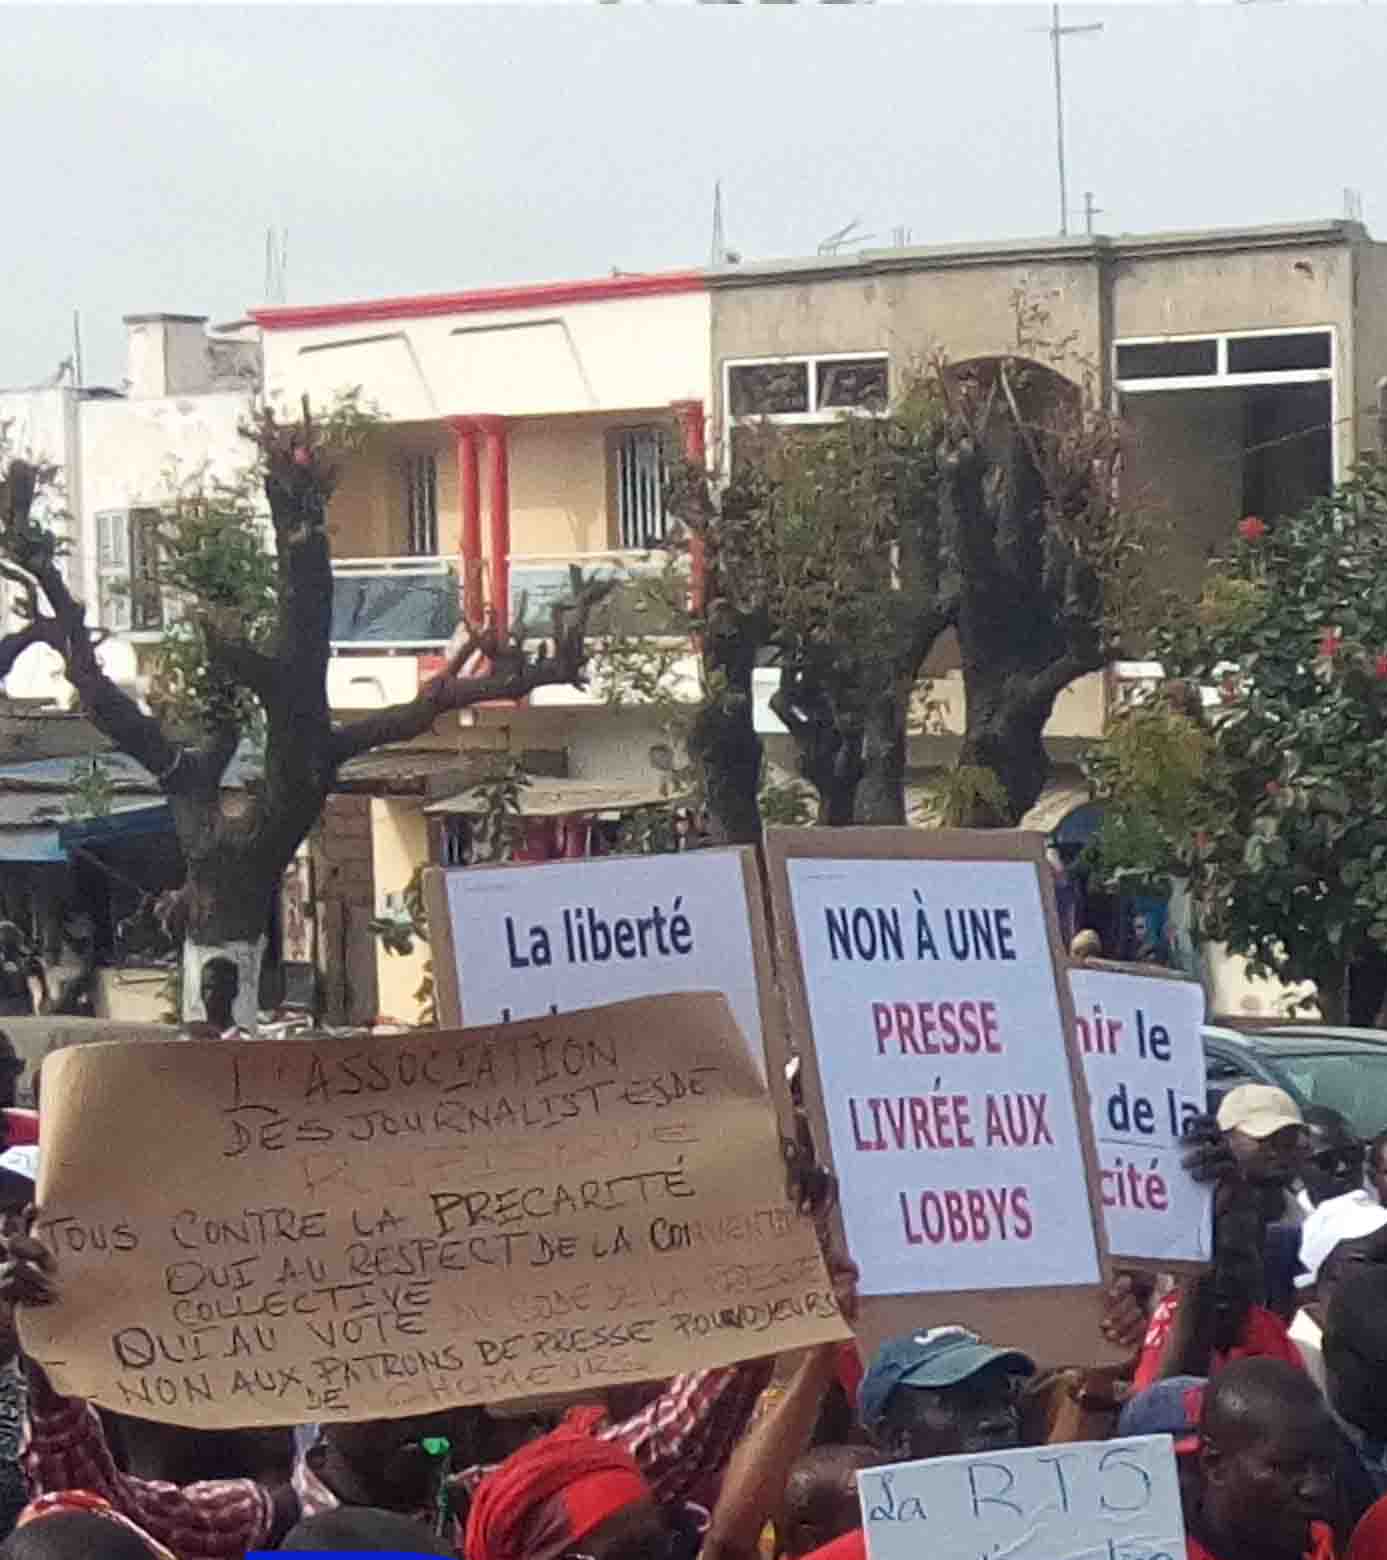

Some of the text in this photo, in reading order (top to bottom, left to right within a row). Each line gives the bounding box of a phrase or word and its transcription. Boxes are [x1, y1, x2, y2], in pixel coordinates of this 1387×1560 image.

[504, 895, 694, 968] La liberté
[824, 888, 1017, 962] NON À UNE
[872, 1000, 1004, 1057] PRESSE
[1135, 1009, 1171, 1062] le
[848, 1076, 1053, 1152] LIVRÉE AUX
[1107, 1082, 1155, 1134] de
[40, 1215, 139, 1254] TOUS
[171, 1207, 328, 1250] CONTRE
[352, 1208, 405, 1237] LA
[899, 1186, 1034, 1246] LOBBYS
[277, 1258, 328, 1287] AU
[345, 1228, 530, 1278] RESPECT
[592, 1226, 631, 1258] LA
[172, 1279, 434, 1325] COLLECTIVE
[307, 1310, 428, 1348] VOTE
[117, 1371, 212, 1406] NON
[231, 1364, 303, 1396] AUX
[534, 1318, 658, 1356] PRESSE
[967, 1447, 1152, 1519] RTS
